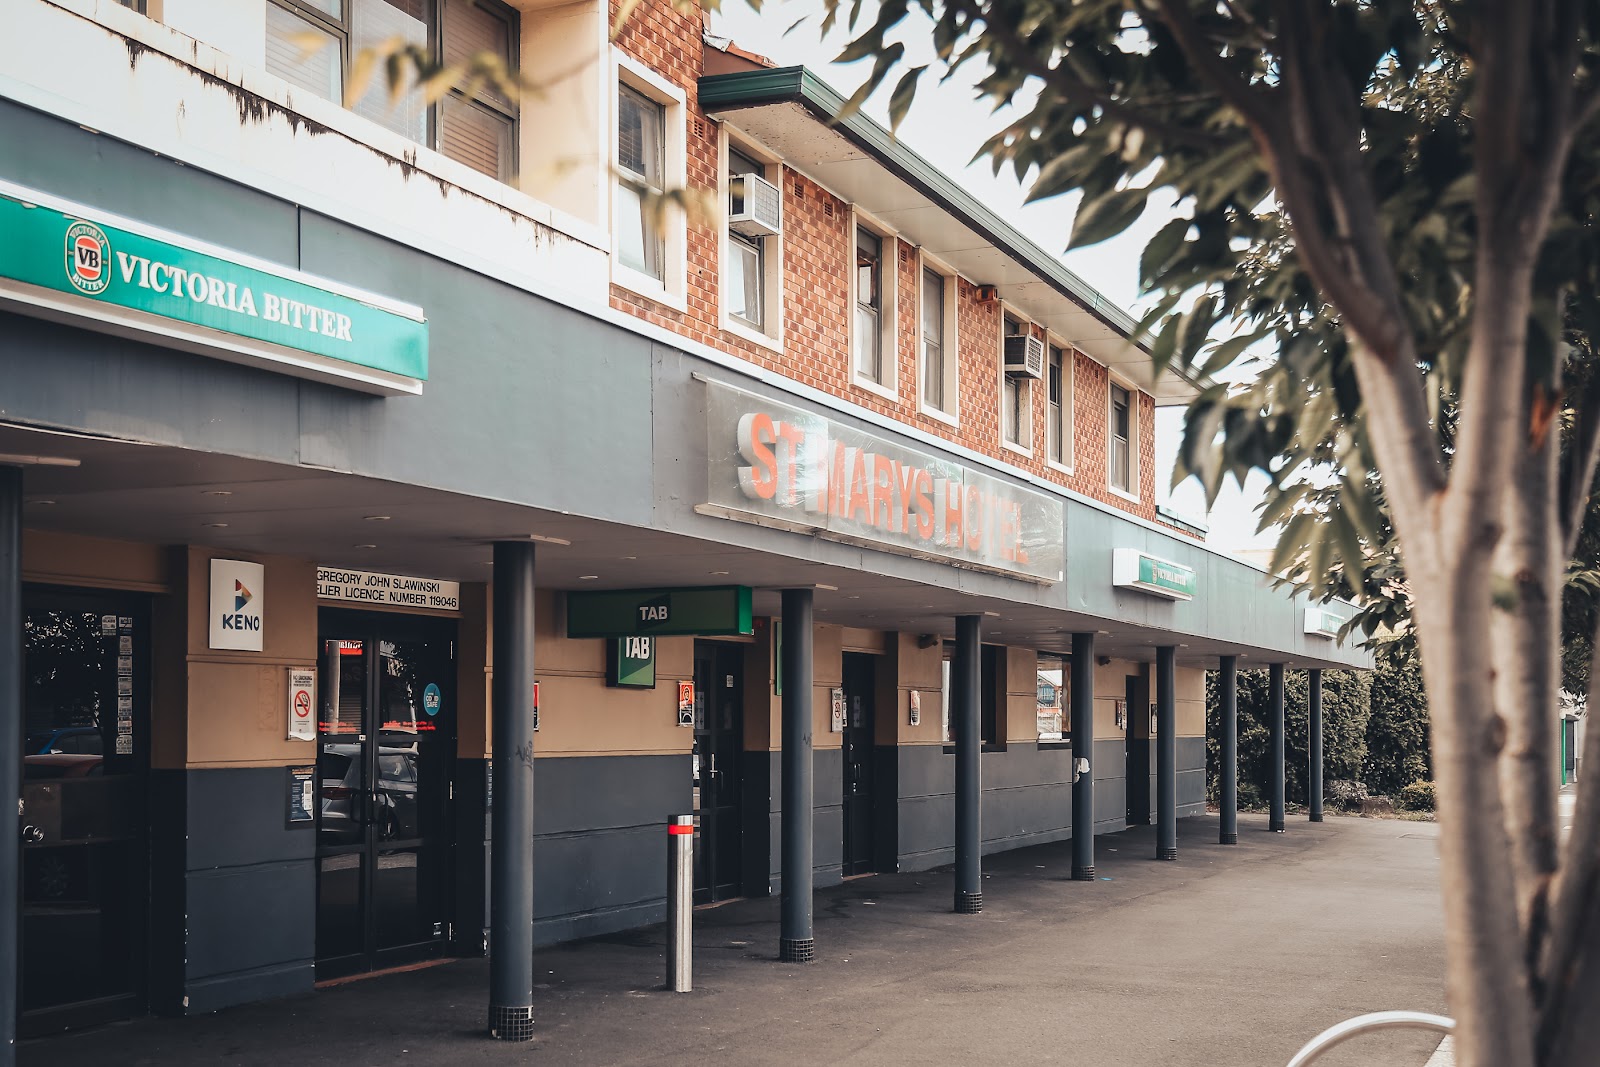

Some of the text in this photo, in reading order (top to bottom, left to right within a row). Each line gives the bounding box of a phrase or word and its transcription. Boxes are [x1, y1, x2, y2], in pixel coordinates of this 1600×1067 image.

[70, 226, 106, 248] VICTORIA
[77, 246, 99, 268] VB
[72, 273, 105, 290] BITTER
[116, 251, 354, 342] VICTORIA BITTER
[737, 412, 1029, 564] ST MARYS HOTEL
[317, 570, 440, 594] GREGORY JOHN SLAWINSKI
[345, 586, 385, 601] LICENCE
[389, 591, 427, 605] NUMBER
[429, 596, 457, 608] 119046
[222, 613, 260, 632] KENO
[639, 606, 668, 620] TAB
